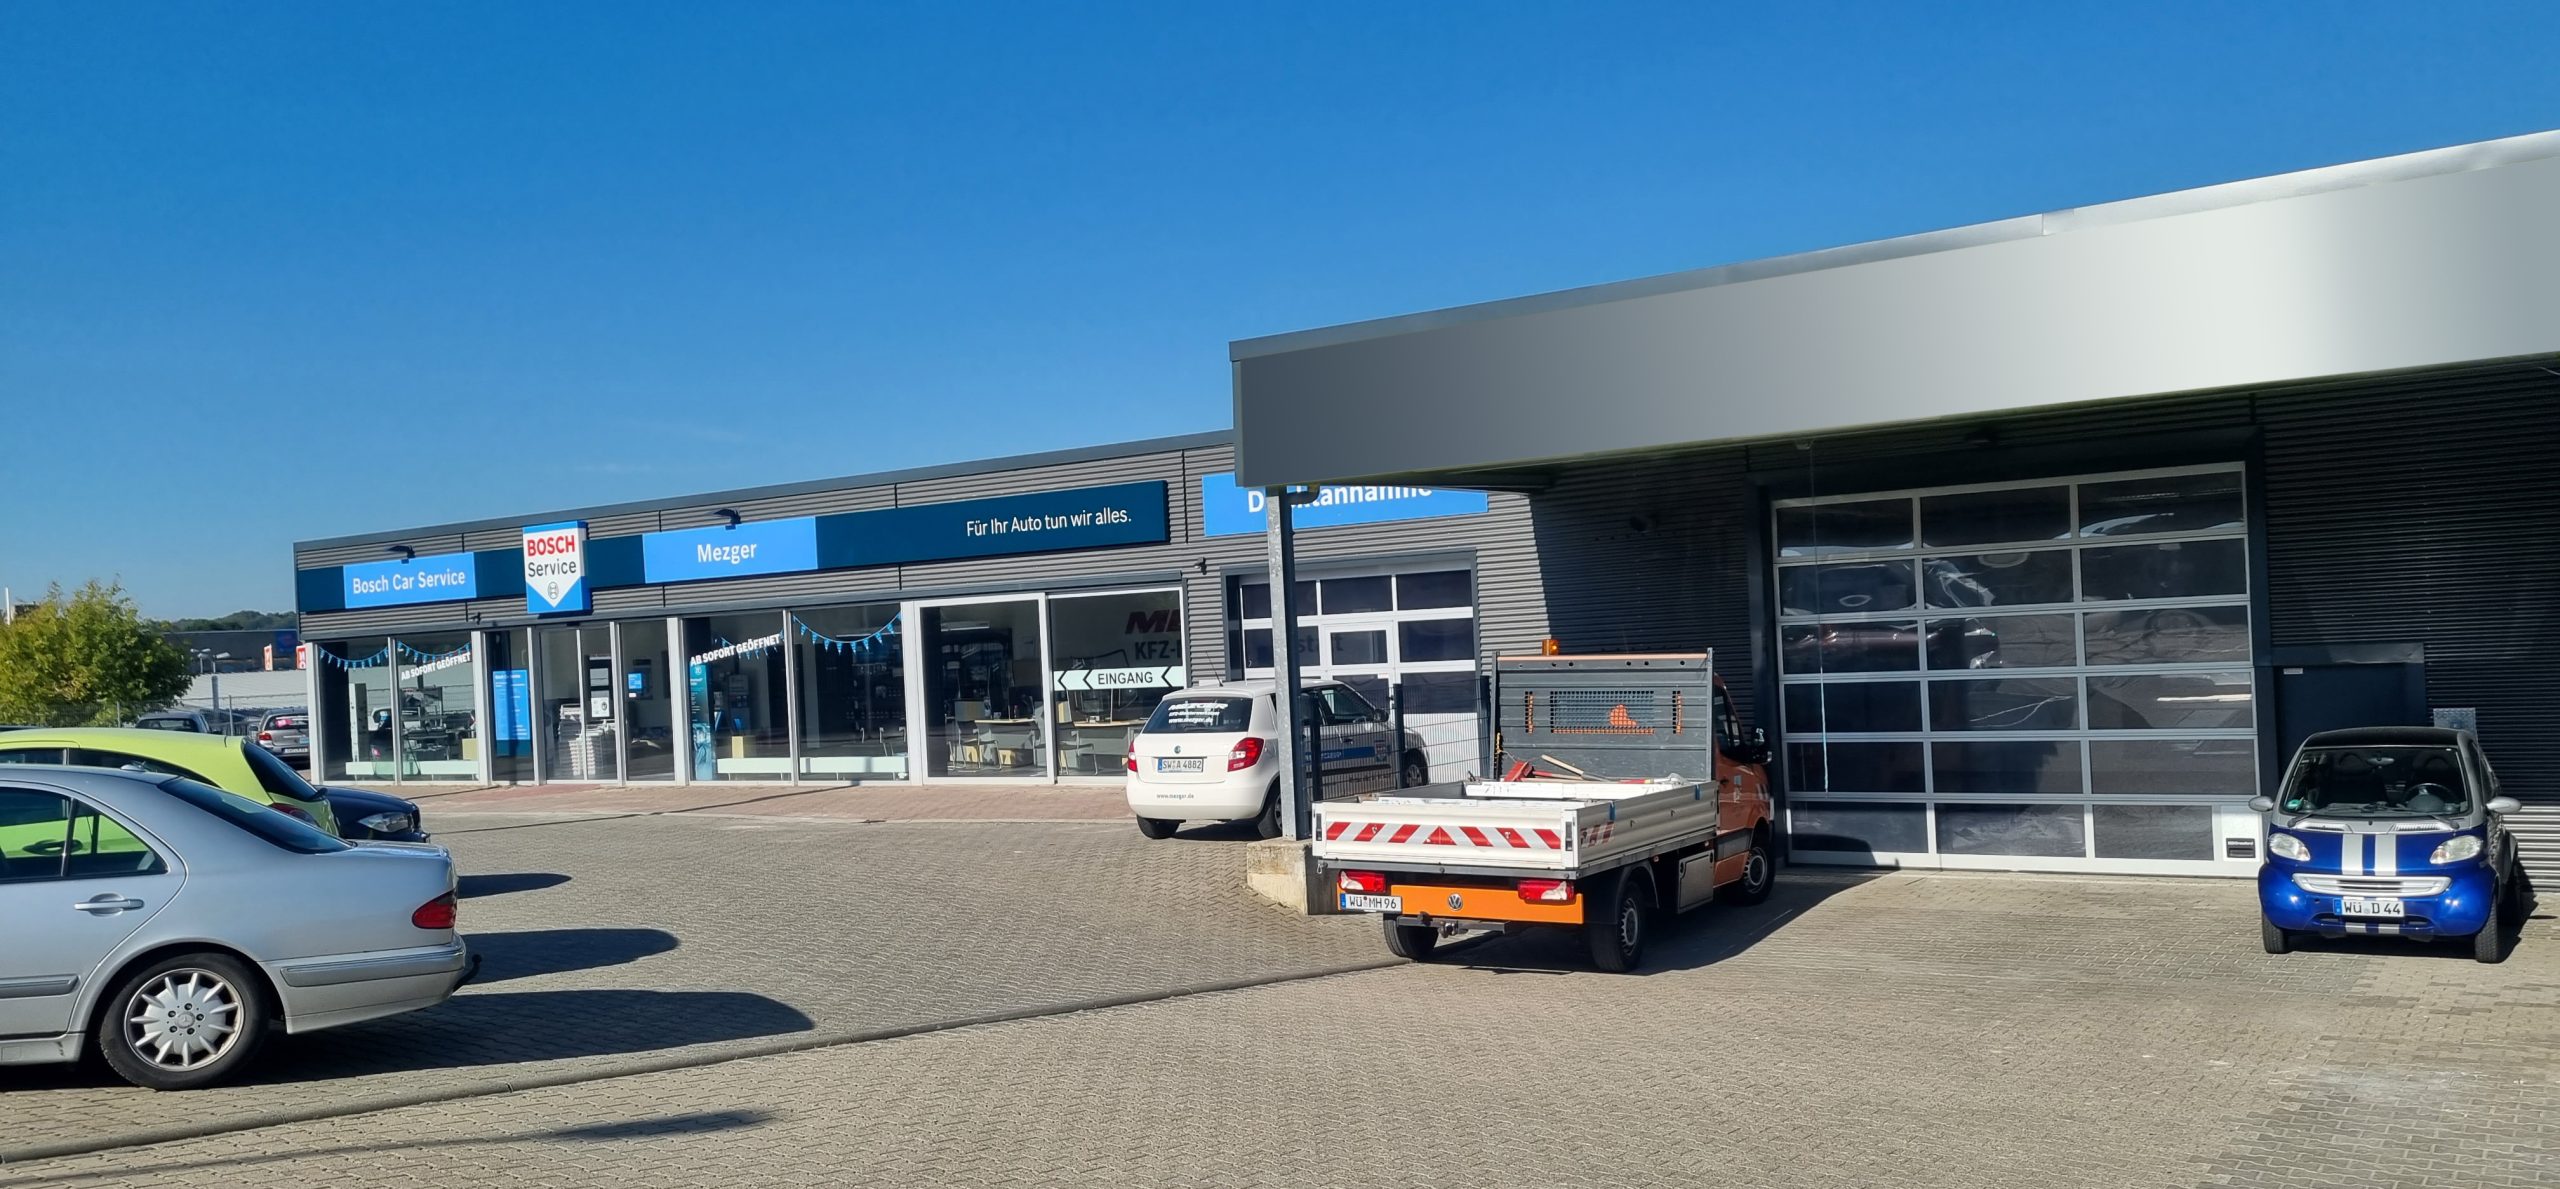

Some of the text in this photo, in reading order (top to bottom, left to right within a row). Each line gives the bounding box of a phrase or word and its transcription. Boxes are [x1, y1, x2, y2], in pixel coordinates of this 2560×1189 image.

[966, 506, 1132, 537] Für Ihr Auto tun wir alles.
[527, 535, 575, 557] BOSCH
[697, 543, 757, 565] Mezger
[528, 558, 577, 578] Service
[353, 568, 465, 595] Bosch Car Service
[690, 633, 780, 667] AB SOFORT GEÖFFNET
[401, 652, 471, 681] AB SOFORT GEÖFFNET
[1098, 671, 1153, 685] EINGANG
[1163, 760, 1202, 770] SW A 4882
[1350, 896, 1397, 909] WÜ MH 96
[2344, 901, 2400, 914] WÜ D 44
